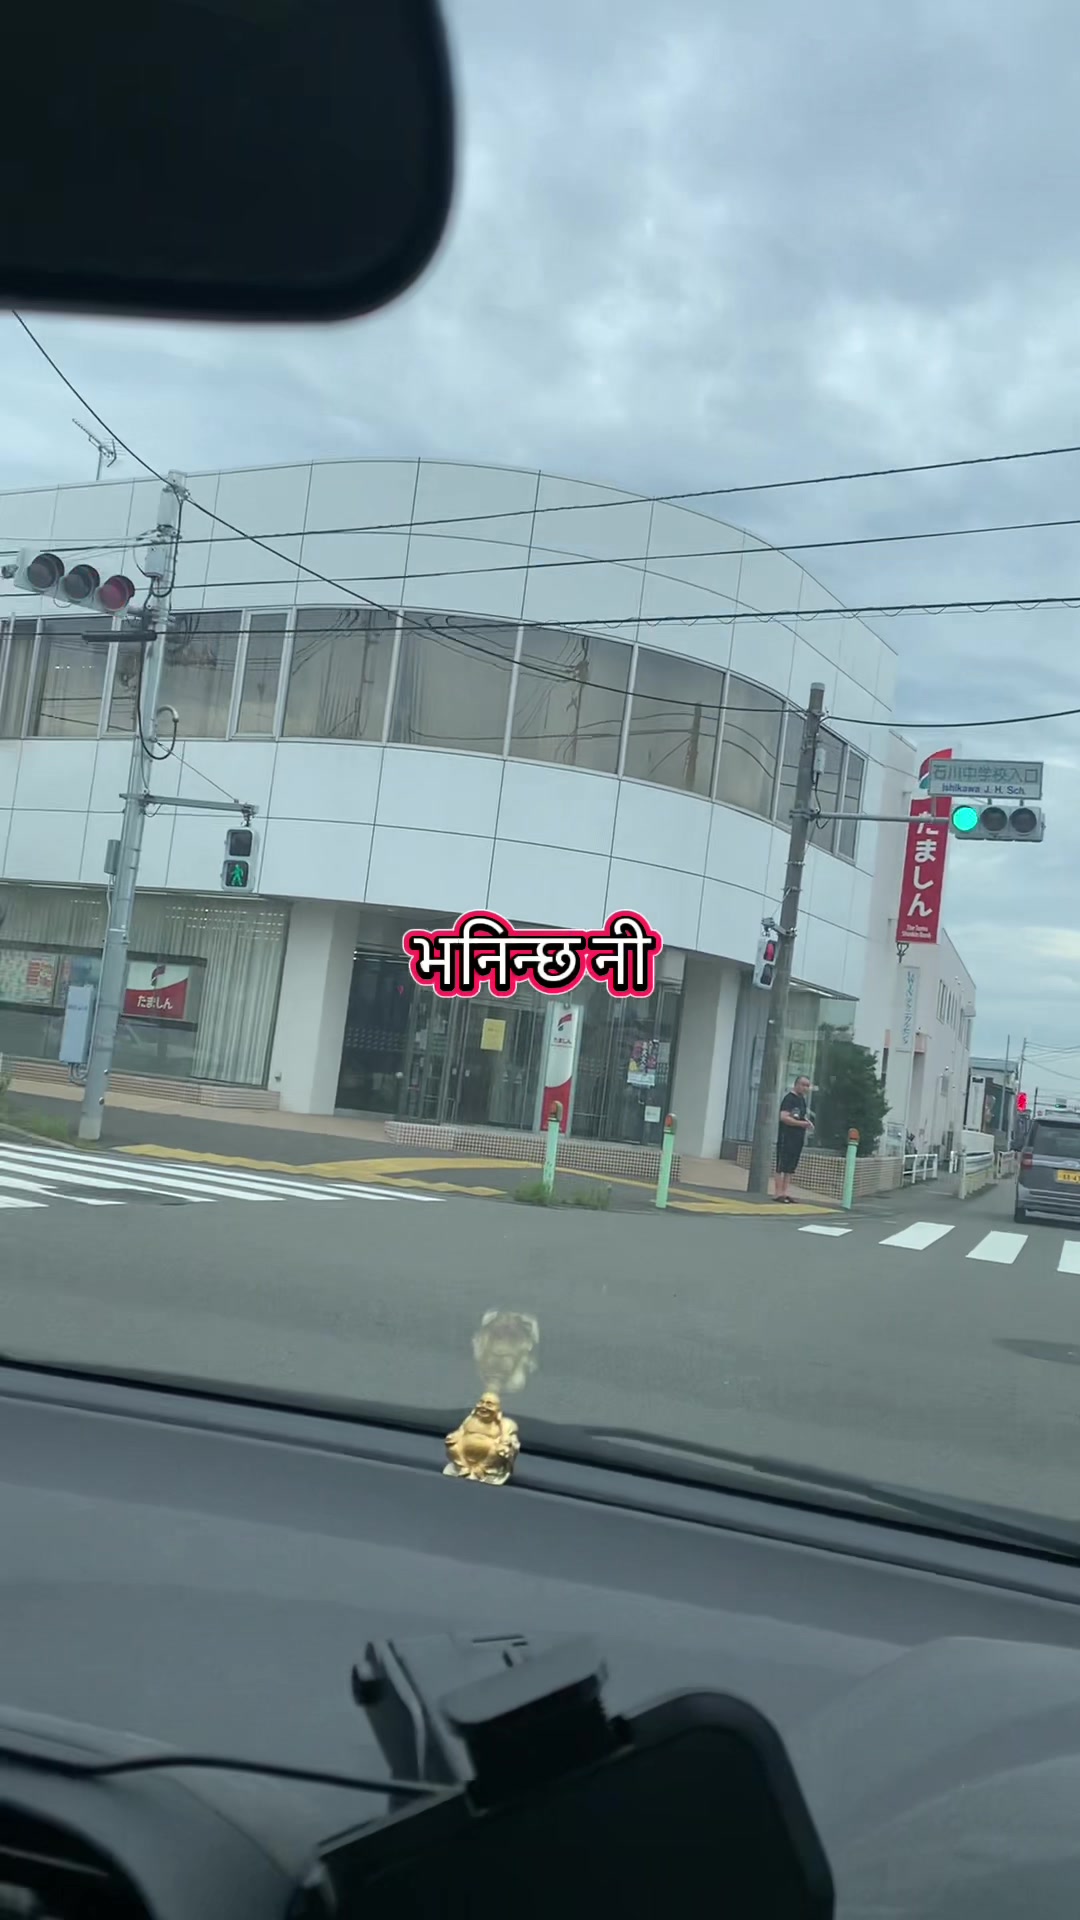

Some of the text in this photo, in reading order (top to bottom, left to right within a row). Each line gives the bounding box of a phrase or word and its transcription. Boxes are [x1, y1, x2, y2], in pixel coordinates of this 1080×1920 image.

[933, 764, 1039, 783] 石川中学校入口
[942, 783, 1026, 795] Ishikawa J. H. Sch.
[137, 995, 173, 1010] たましん
